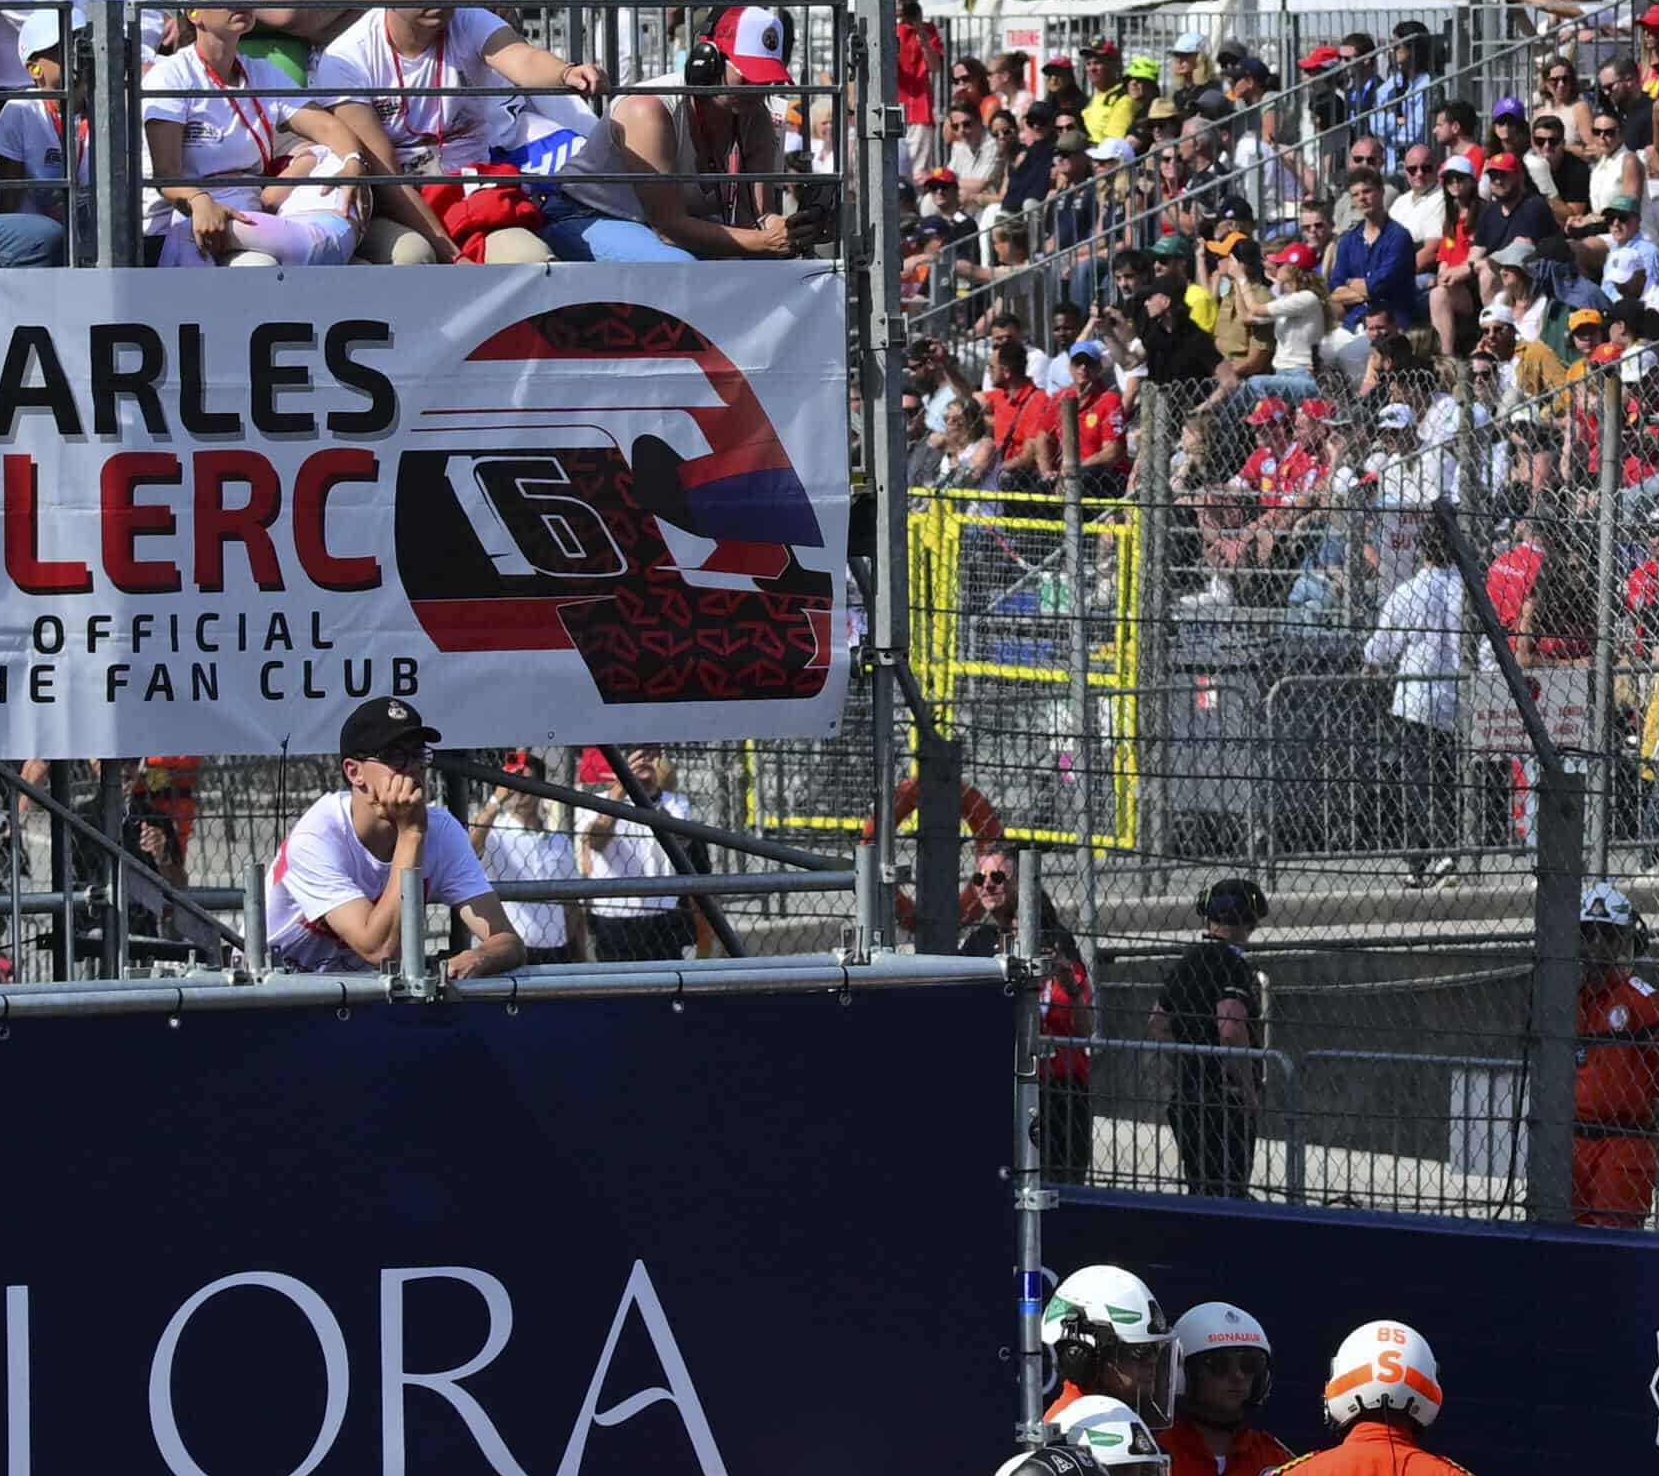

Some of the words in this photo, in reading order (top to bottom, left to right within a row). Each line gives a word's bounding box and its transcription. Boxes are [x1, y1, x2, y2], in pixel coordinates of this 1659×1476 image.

[444, 454, 632, 581] 16
[35, 611, 335, 655] OFFICIAL
[107, 659, 219, 704] FAN
[259, 657, 421, 701] CLUB
[1376, 1350, 1403, 1384] S
